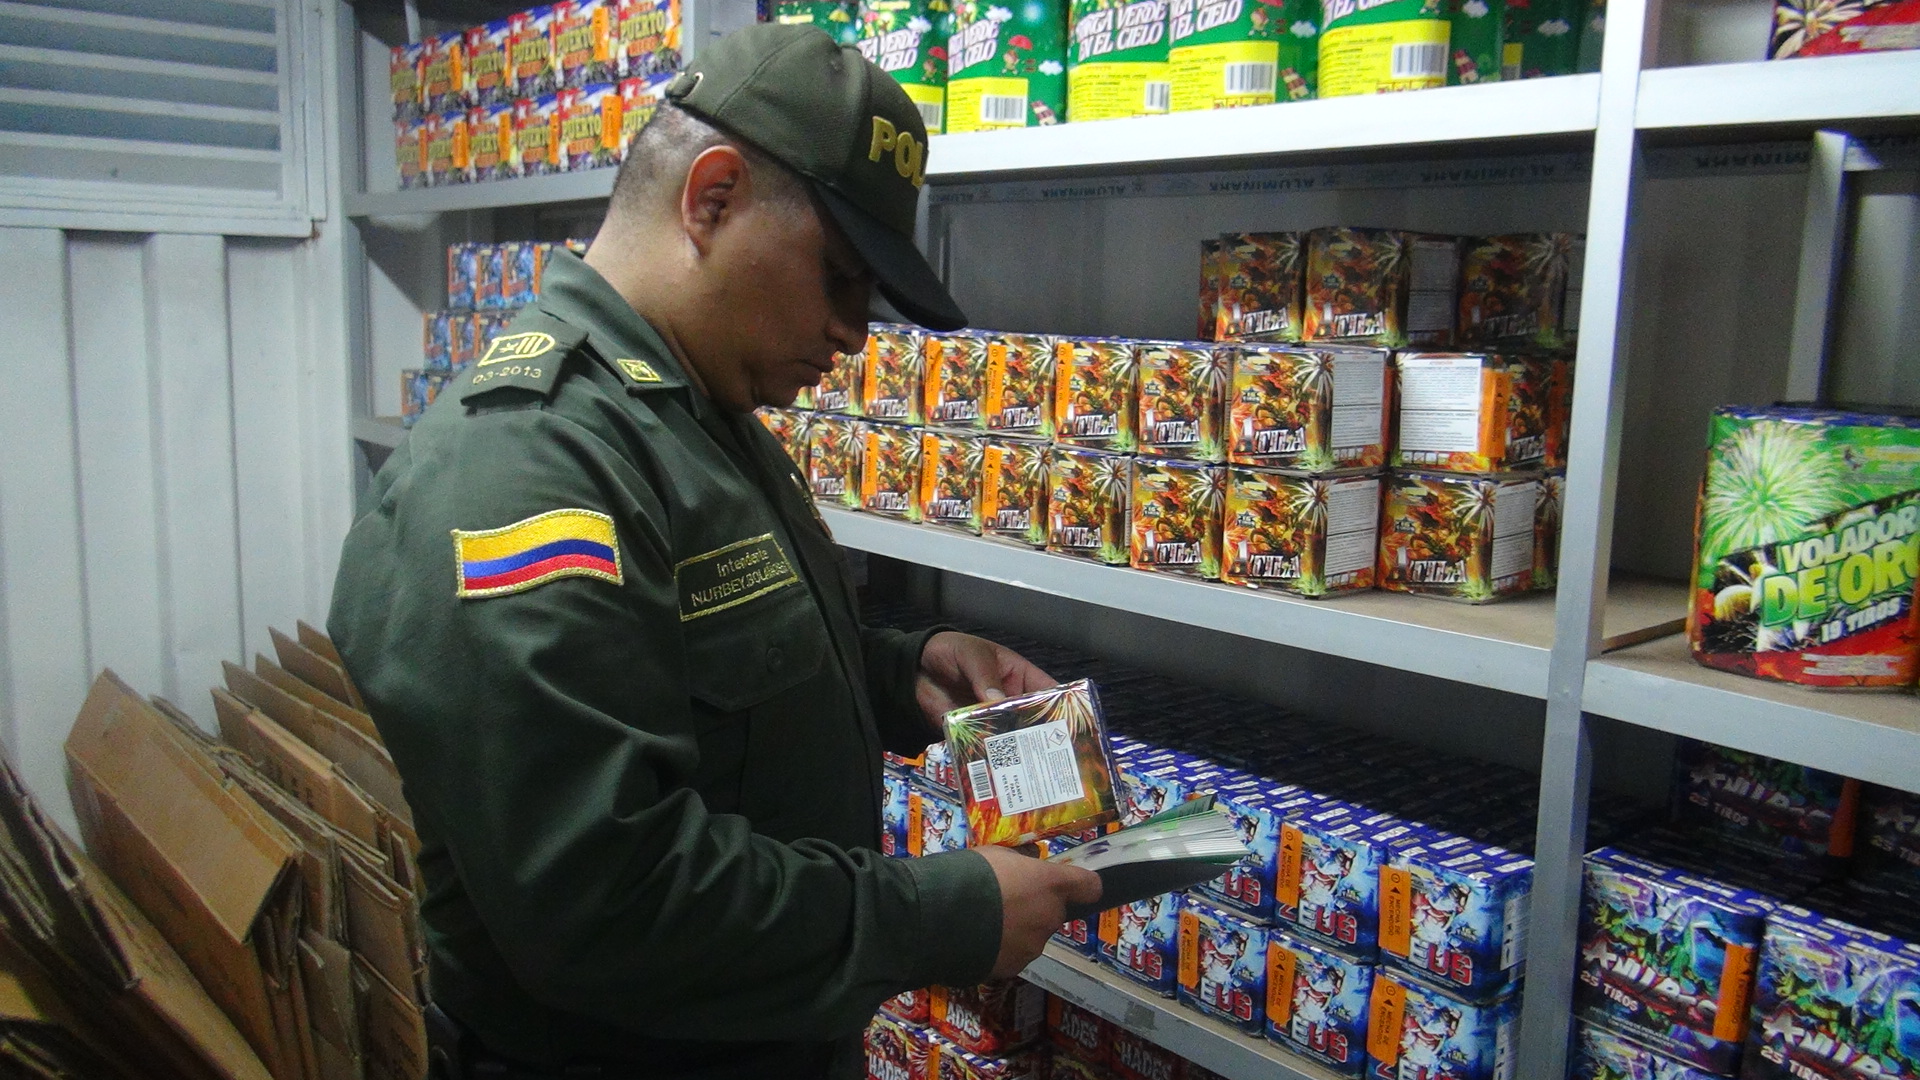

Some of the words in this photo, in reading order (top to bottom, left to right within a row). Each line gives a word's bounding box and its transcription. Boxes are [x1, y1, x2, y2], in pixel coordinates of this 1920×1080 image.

[620, 9, 666, 42] PUERTO
[1117, 0, 1169, 31] VERDE
[1197, 0, 1244, 32] CIELO
[1093, 31, 1114, 56] EL
[1116, 21, 1165, 50] CIELO
[1763, 566, 1827, 627] DE
[1846, 597, 1901, 631] TIROS
[1580, 969, 1599, 988] 25
[1603, 982, 1639, 1013] TIROS
[946, 1001, 981, 1039] ADES
[1059, 1009, 1098, 1049] ADES
[1760, 1045, 1784, 1065] 25
